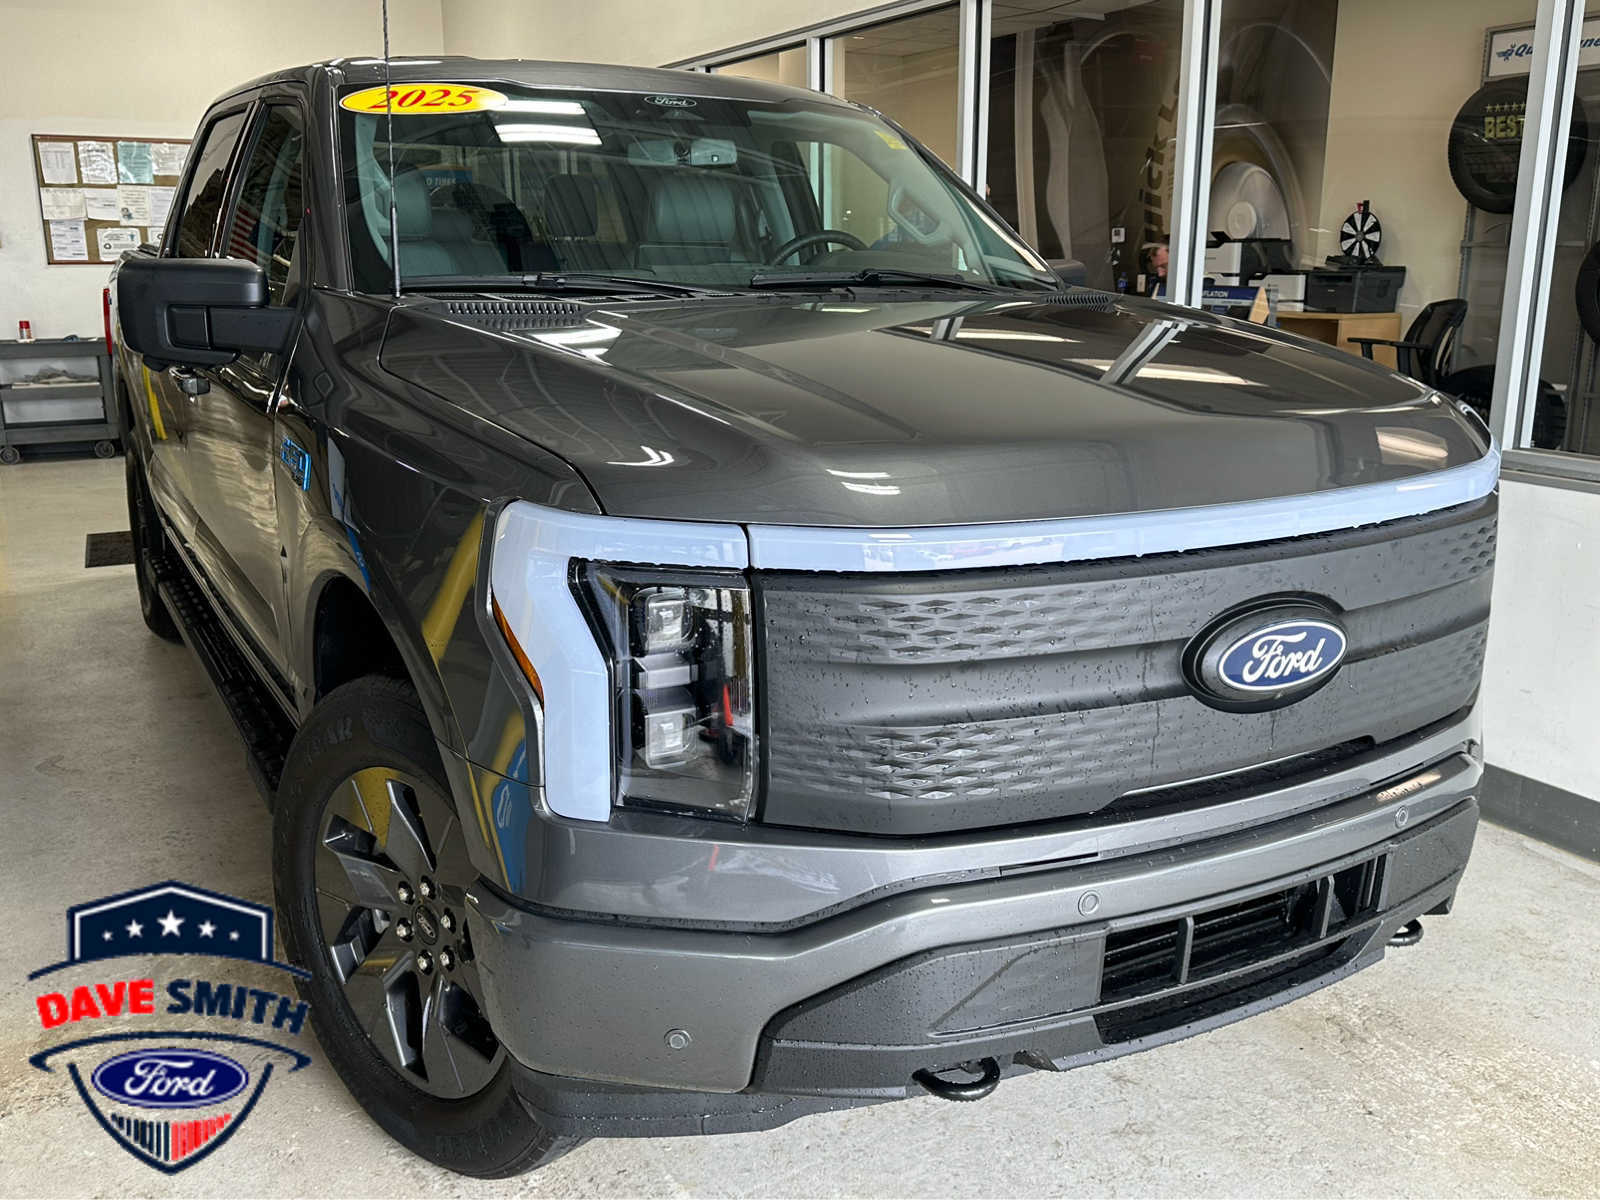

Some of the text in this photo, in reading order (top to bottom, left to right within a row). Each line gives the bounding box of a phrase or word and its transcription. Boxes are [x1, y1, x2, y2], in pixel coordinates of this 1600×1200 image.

[367, 88, 481, 110] 2025
[653, 95, 688, 106] Ford
[1484, 114, 1526, 139] BEST
[1242, 631, 1326, 683] Ford
